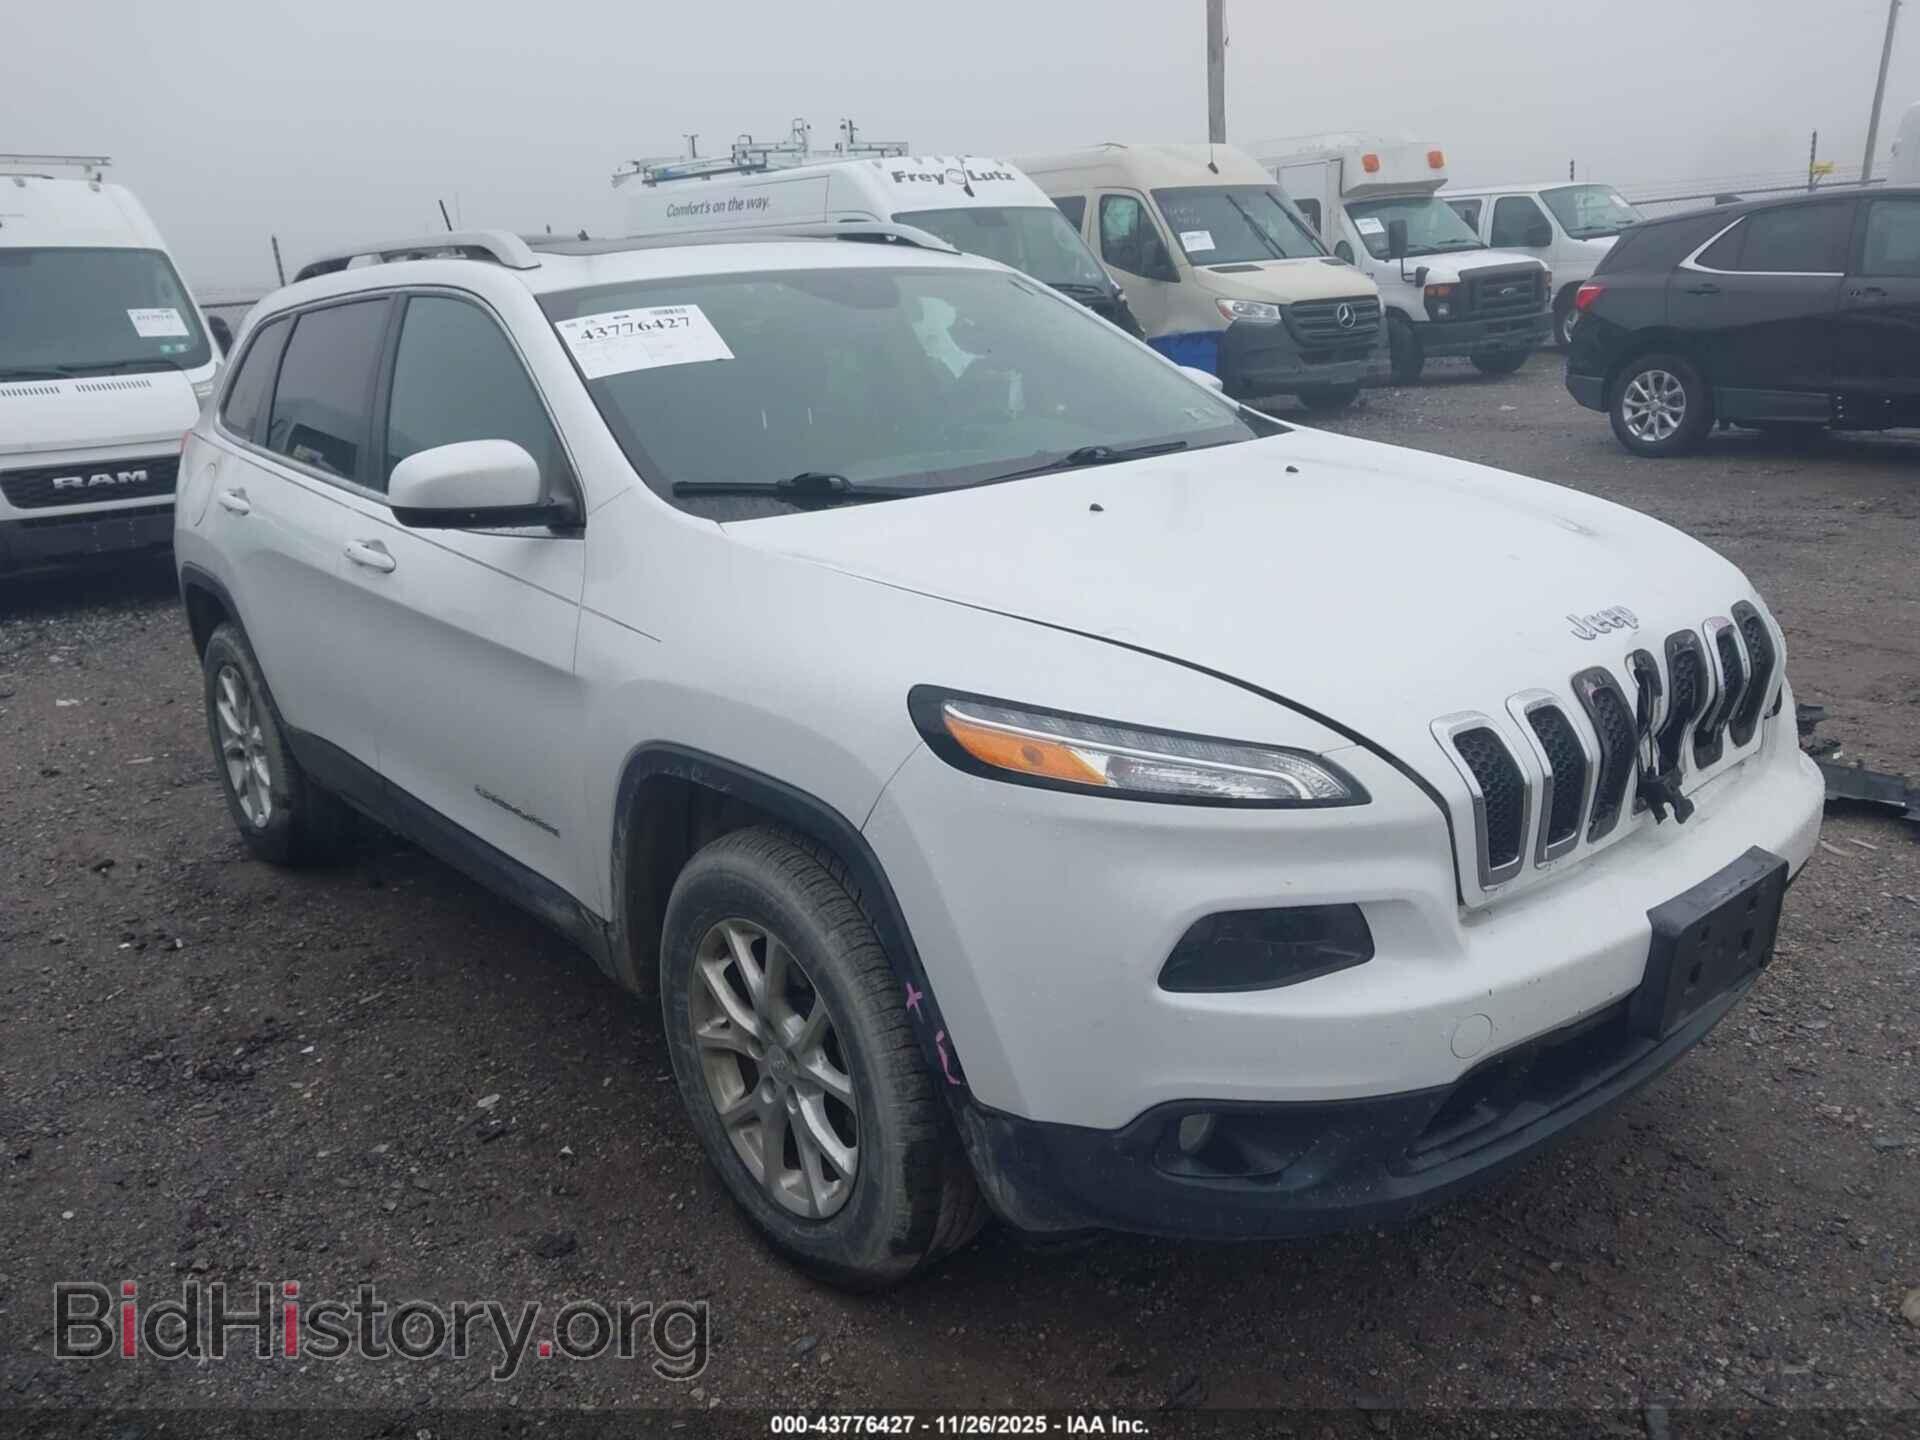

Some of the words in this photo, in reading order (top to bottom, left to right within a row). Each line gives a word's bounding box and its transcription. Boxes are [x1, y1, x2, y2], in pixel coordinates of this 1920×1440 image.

[892, 170, 945, 186] Frey
[966, 169, 1016, 182] Lutz
[666, 200, 712, 218] Comfort's
[712, 201, 726, 213] on
[728, 196, 745, 212] the
[746, 196, 771, 212] way.
[580, 317, 691, 341] 43776427
[52, 469, 148, 489] RAM
[1565, 605, 1640, 641] Jeep
